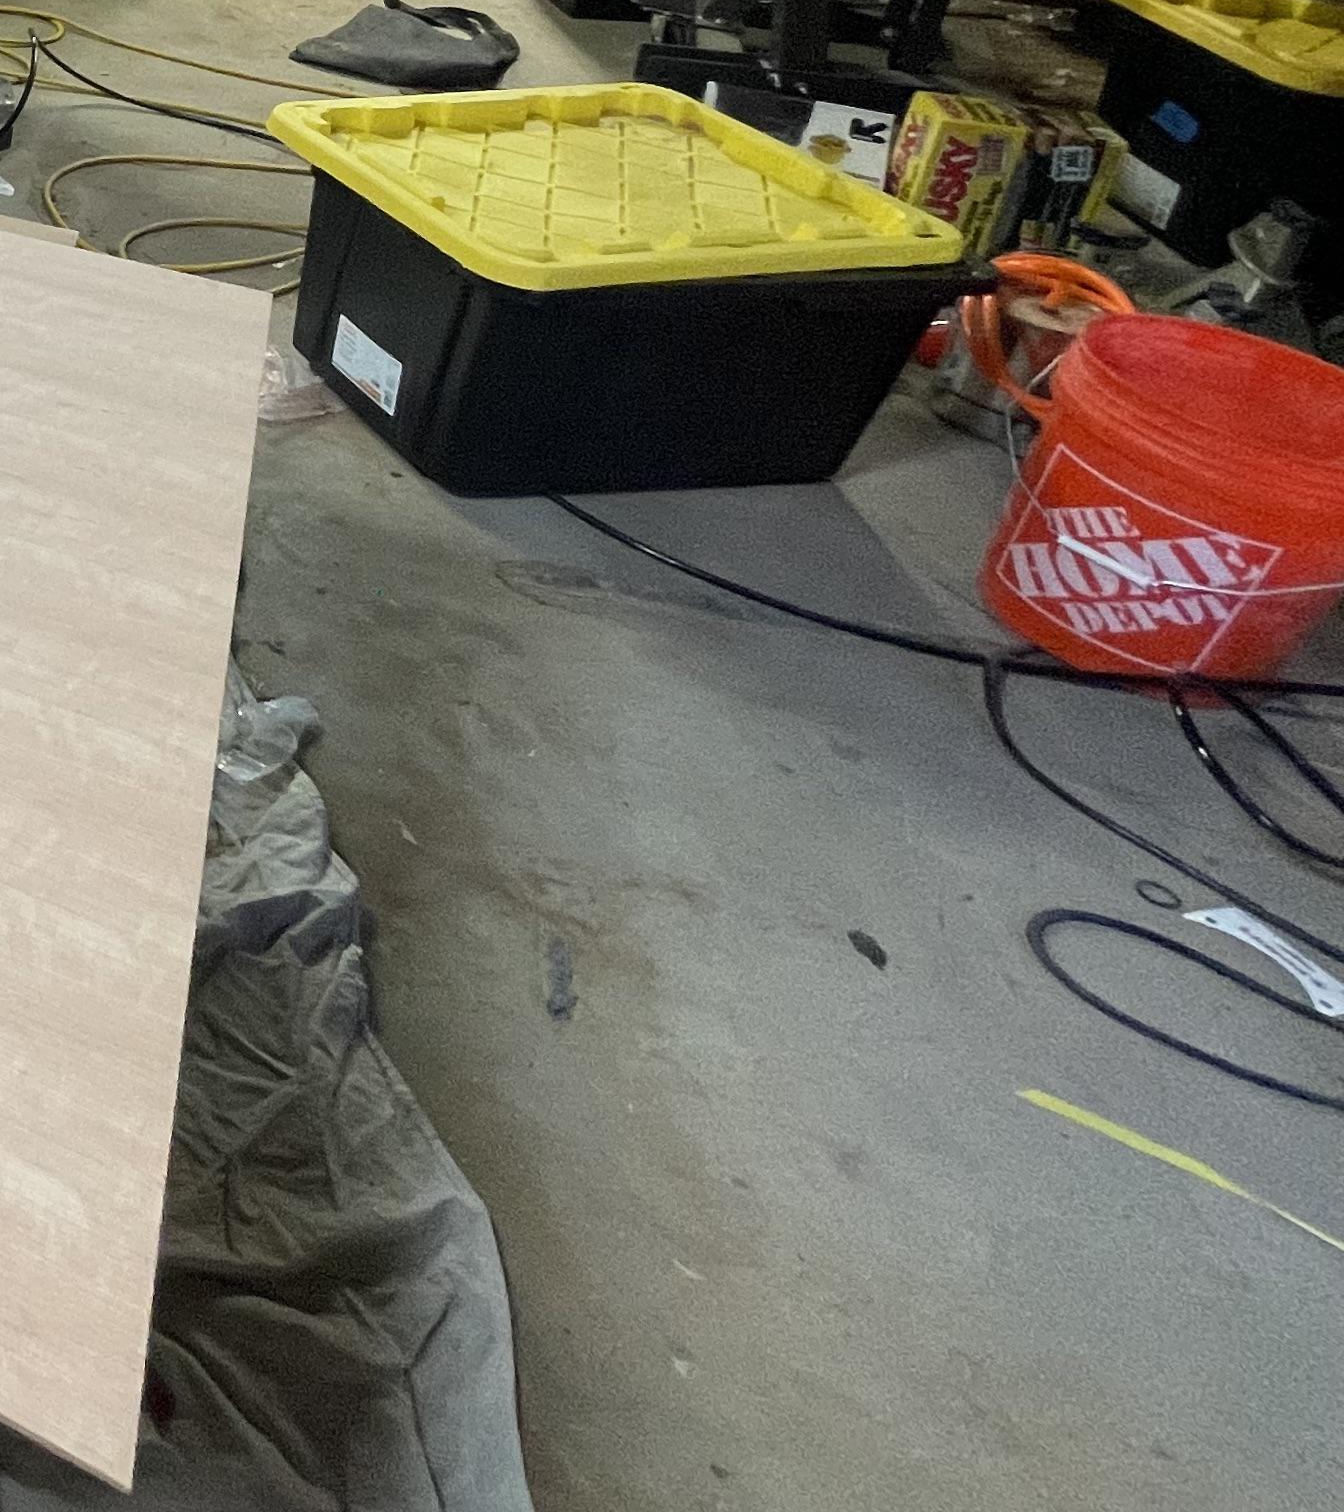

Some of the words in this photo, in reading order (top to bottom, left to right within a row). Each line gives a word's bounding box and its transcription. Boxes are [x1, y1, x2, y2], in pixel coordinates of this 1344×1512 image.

[922, 134, 979, 223] USKY
[1045, 506, 1142, 539] THE
[1009, 531, 1264, 598] HOME
[1061, 593, 1233, 636] DEPOT
